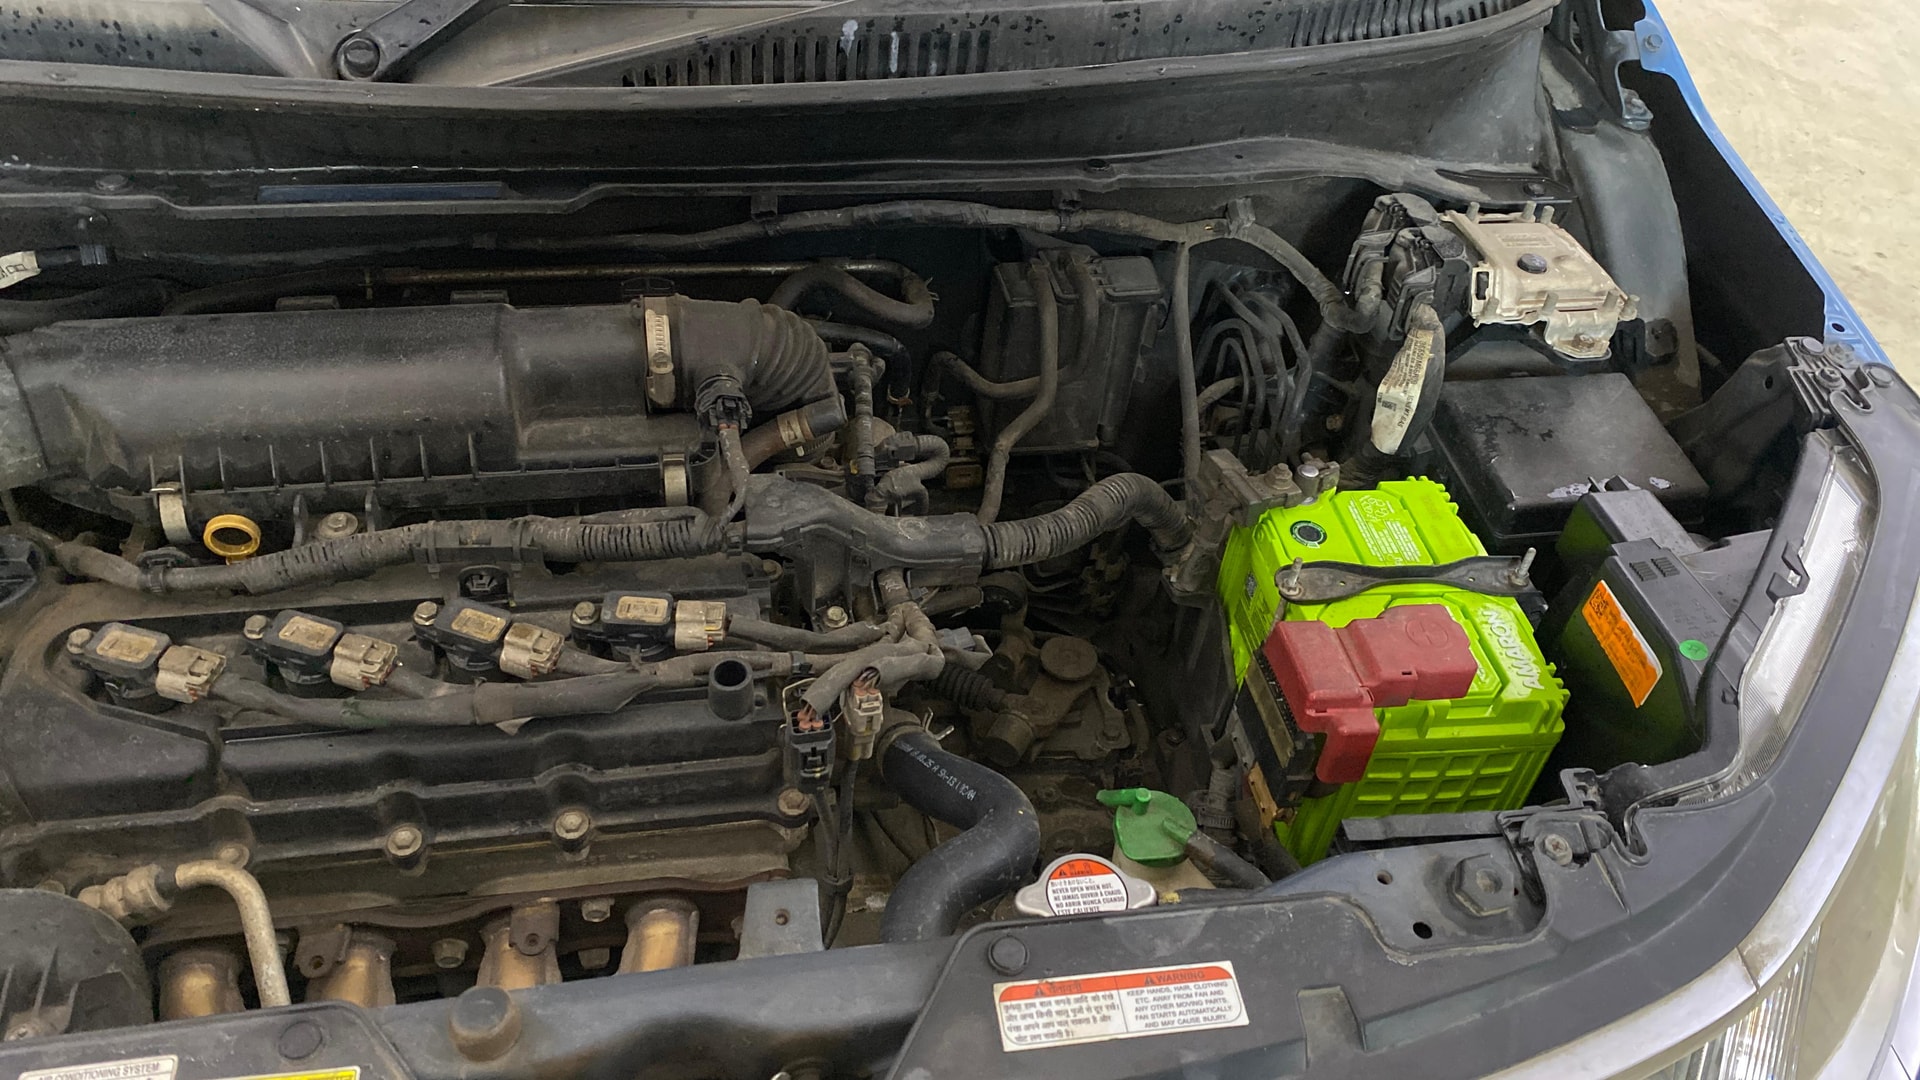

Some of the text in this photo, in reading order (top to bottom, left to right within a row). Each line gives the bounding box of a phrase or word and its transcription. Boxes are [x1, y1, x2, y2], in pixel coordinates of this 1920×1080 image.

[1482, 610, 1545, 690] AMARON
[1062, 893, 1080, 901] JAMAIS
[1103, 896, 1125, 904] CUANDO
[1156, 970, 1205, 983] WARNING
[1127, 981, 1228, 997] KEEP HANDS, HAIR, CLOTHING
[1150, 1003, 1174, 1011] OTHER
[1176, 1000, 1204, 1008] MOVING
[1135, 1005, 1232, 1021] FAN STARTS AUTOMATICALLY
[1177, 1017, 1201, 1025] CAUSE
[122, 1062, 160, 1075] SYSTEM
